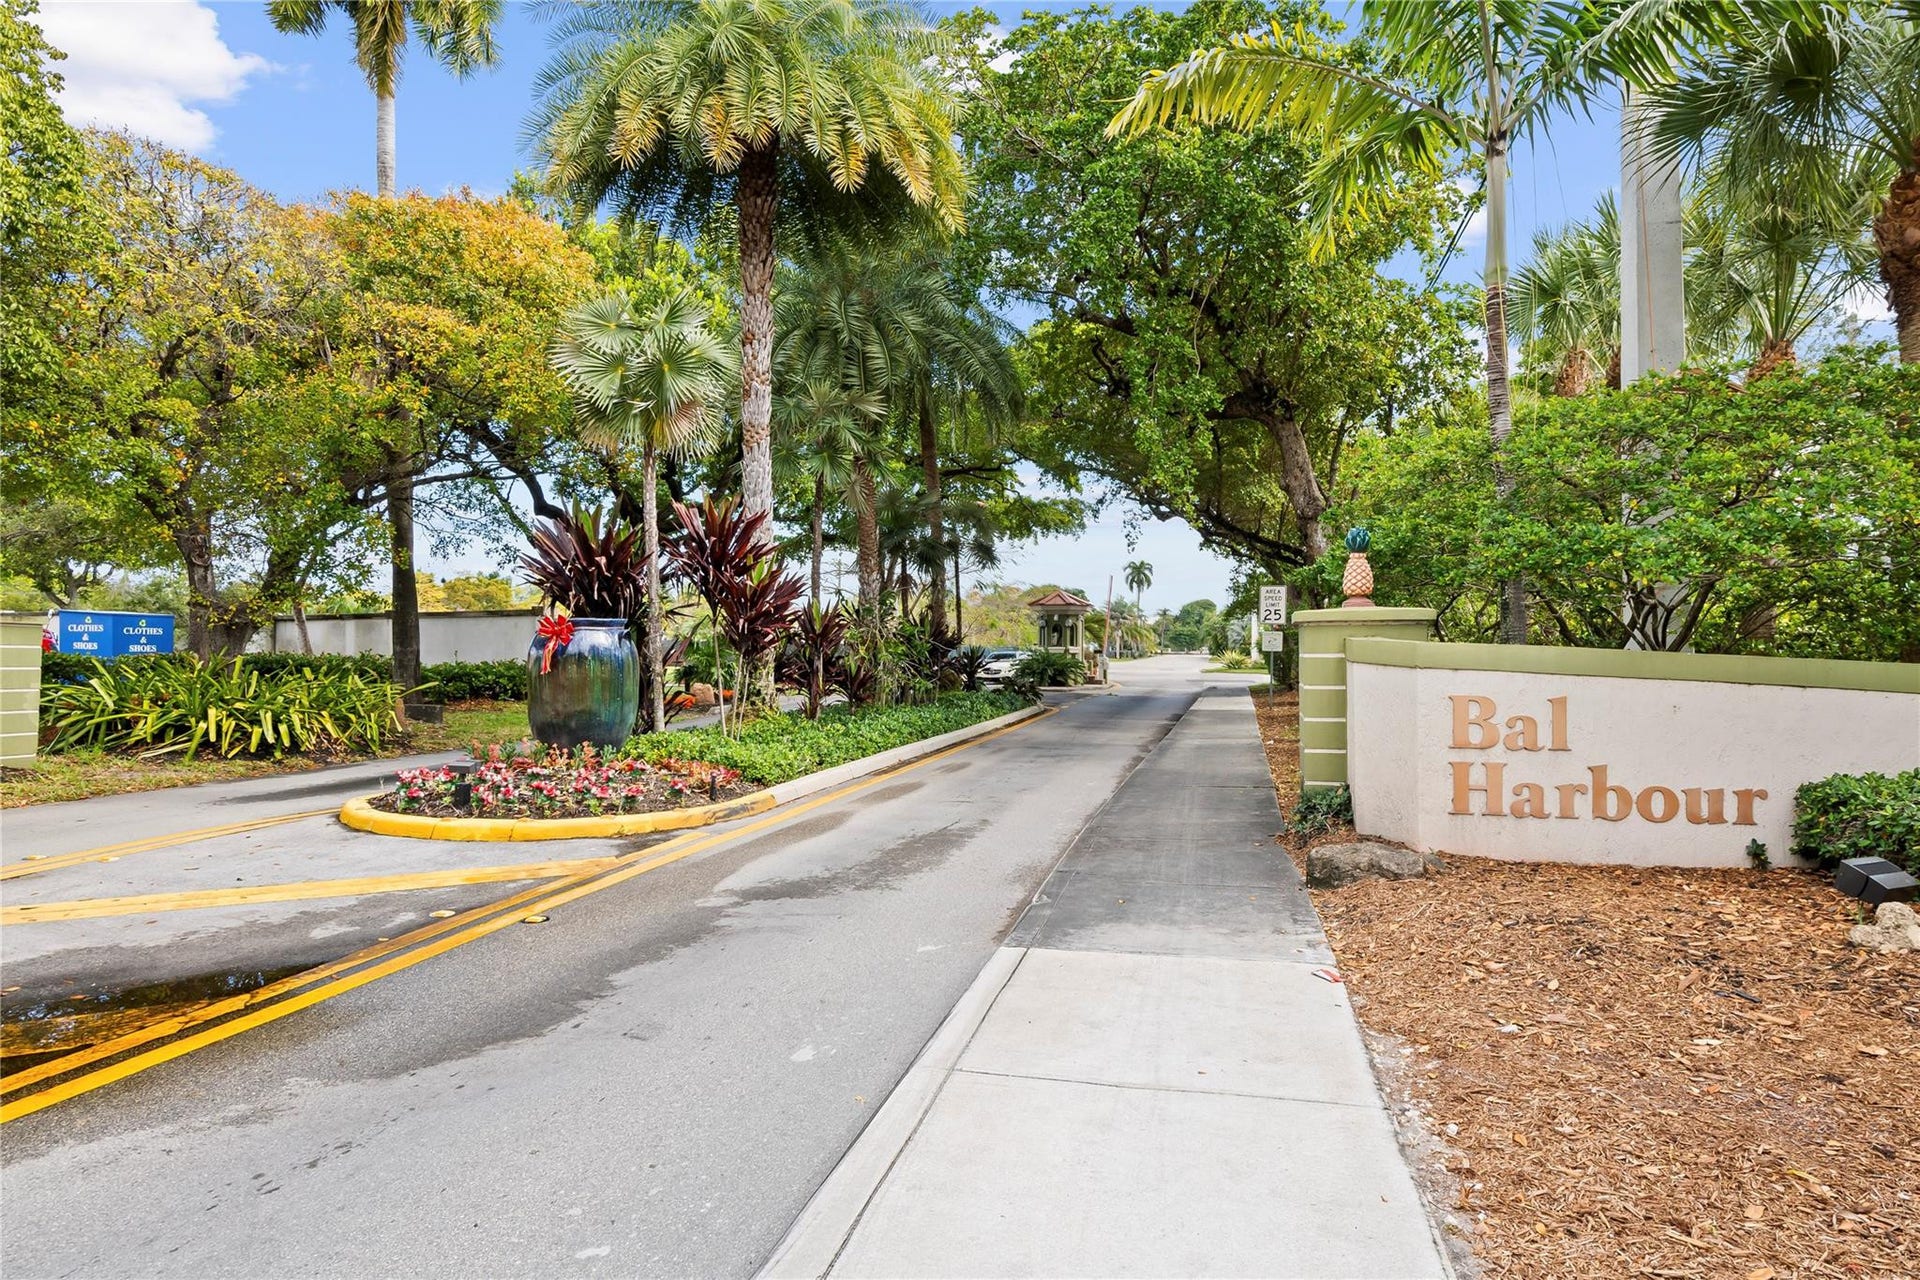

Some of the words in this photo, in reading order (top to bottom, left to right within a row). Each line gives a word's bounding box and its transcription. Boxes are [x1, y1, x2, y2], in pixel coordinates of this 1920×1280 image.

[1264, 609, 1282, 621] 25
[68, 624, 104, 632] CLOTHES
[123, 627, 163, 635] CLOTHES
[82, 633, 89, 641] &
[73, 642, 98, 650] SHOES
[129, 644, 157, 652] SHOES
[1448, 695, 1572, 752] Bal
[1448, 761, 1768, 826] Harbour
